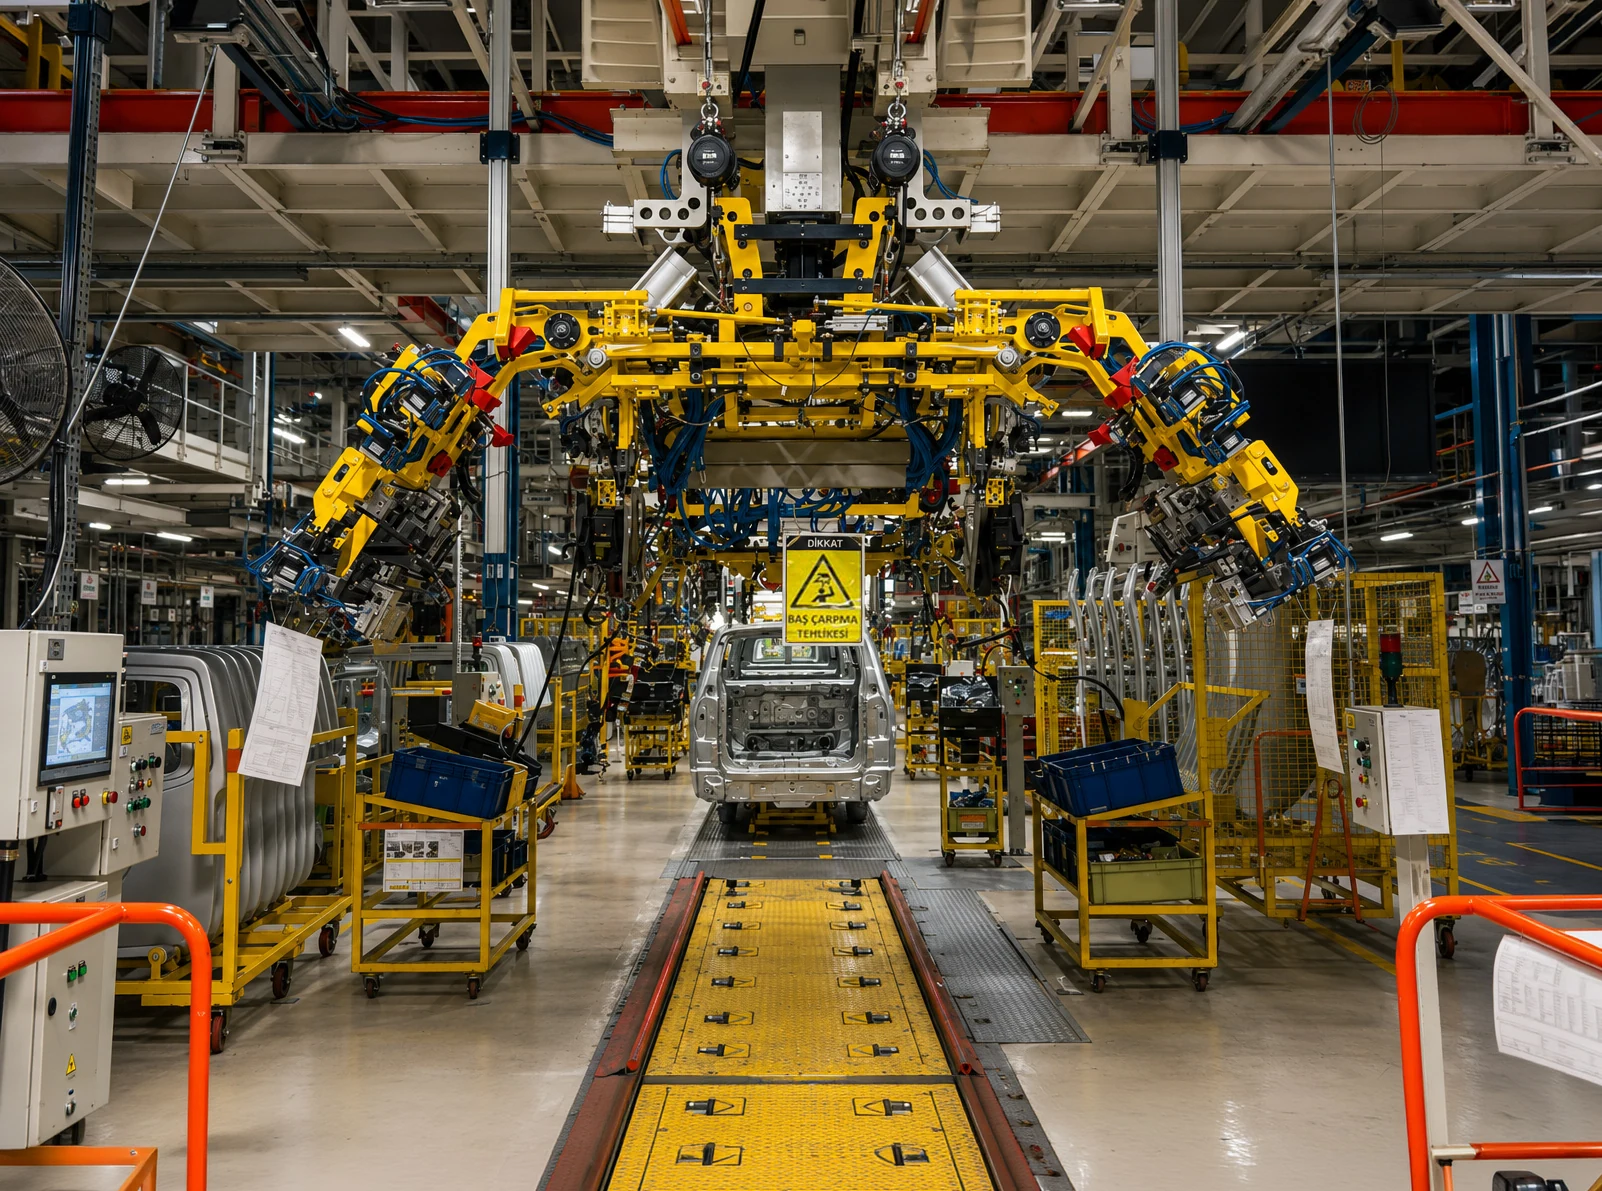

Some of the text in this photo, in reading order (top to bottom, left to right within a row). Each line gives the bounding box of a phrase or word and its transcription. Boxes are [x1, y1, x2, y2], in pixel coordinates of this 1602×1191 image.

[807, 537, 844, 548] DİKKAT
[788, 614, 858, 626] BAŞ ÇARPMA
[796, 628, 849, 639] TEHLİKESİ
